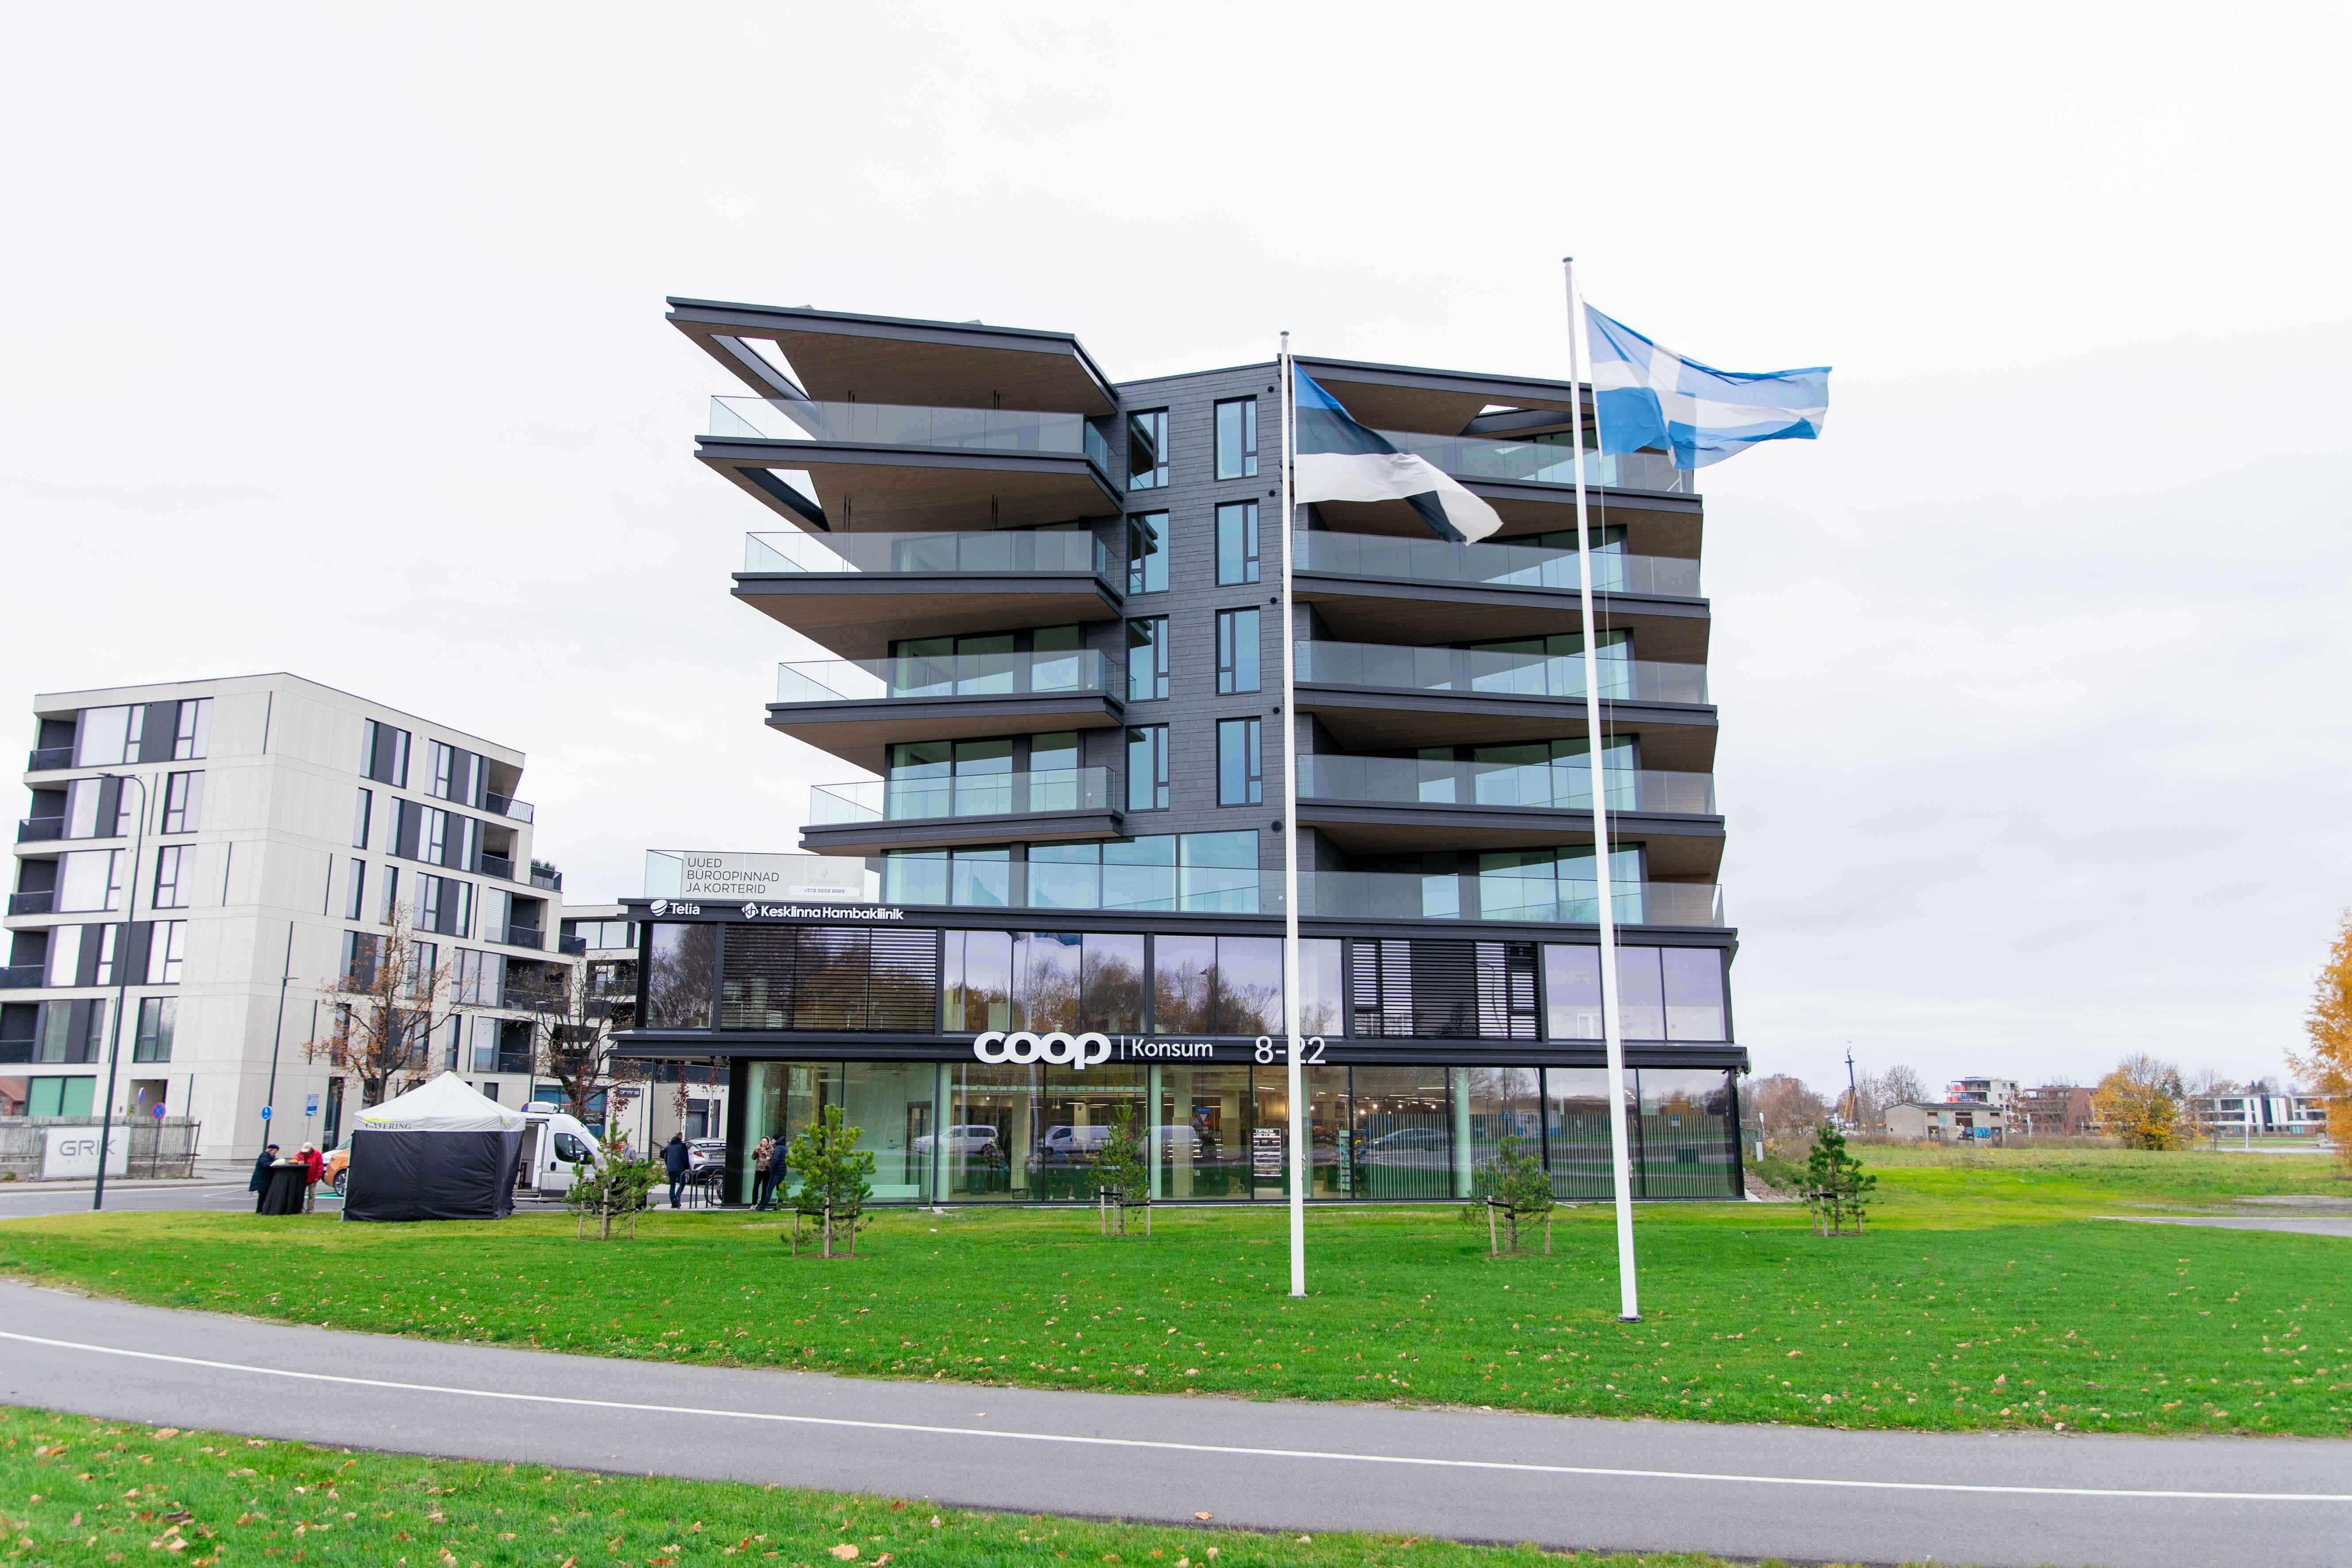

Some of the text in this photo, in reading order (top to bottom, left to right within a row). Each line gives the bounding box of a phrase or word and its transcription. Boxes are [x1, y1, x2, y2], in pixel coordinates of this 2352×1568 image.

[688, 857, 722, 868] UUED
[687, 869, 779, 882] BÜROOPINNAD
[686, 882, 765, 893] JA KORTERID
[669, 903, 700, 915] Telia
[761, 905, 820, 918] Kesklinna
[823, 907, 904, 920] Hambakliinik
[973, 1031, 1112, 1070] coop
[1132, 1039, 1213, 1057] Konsum
